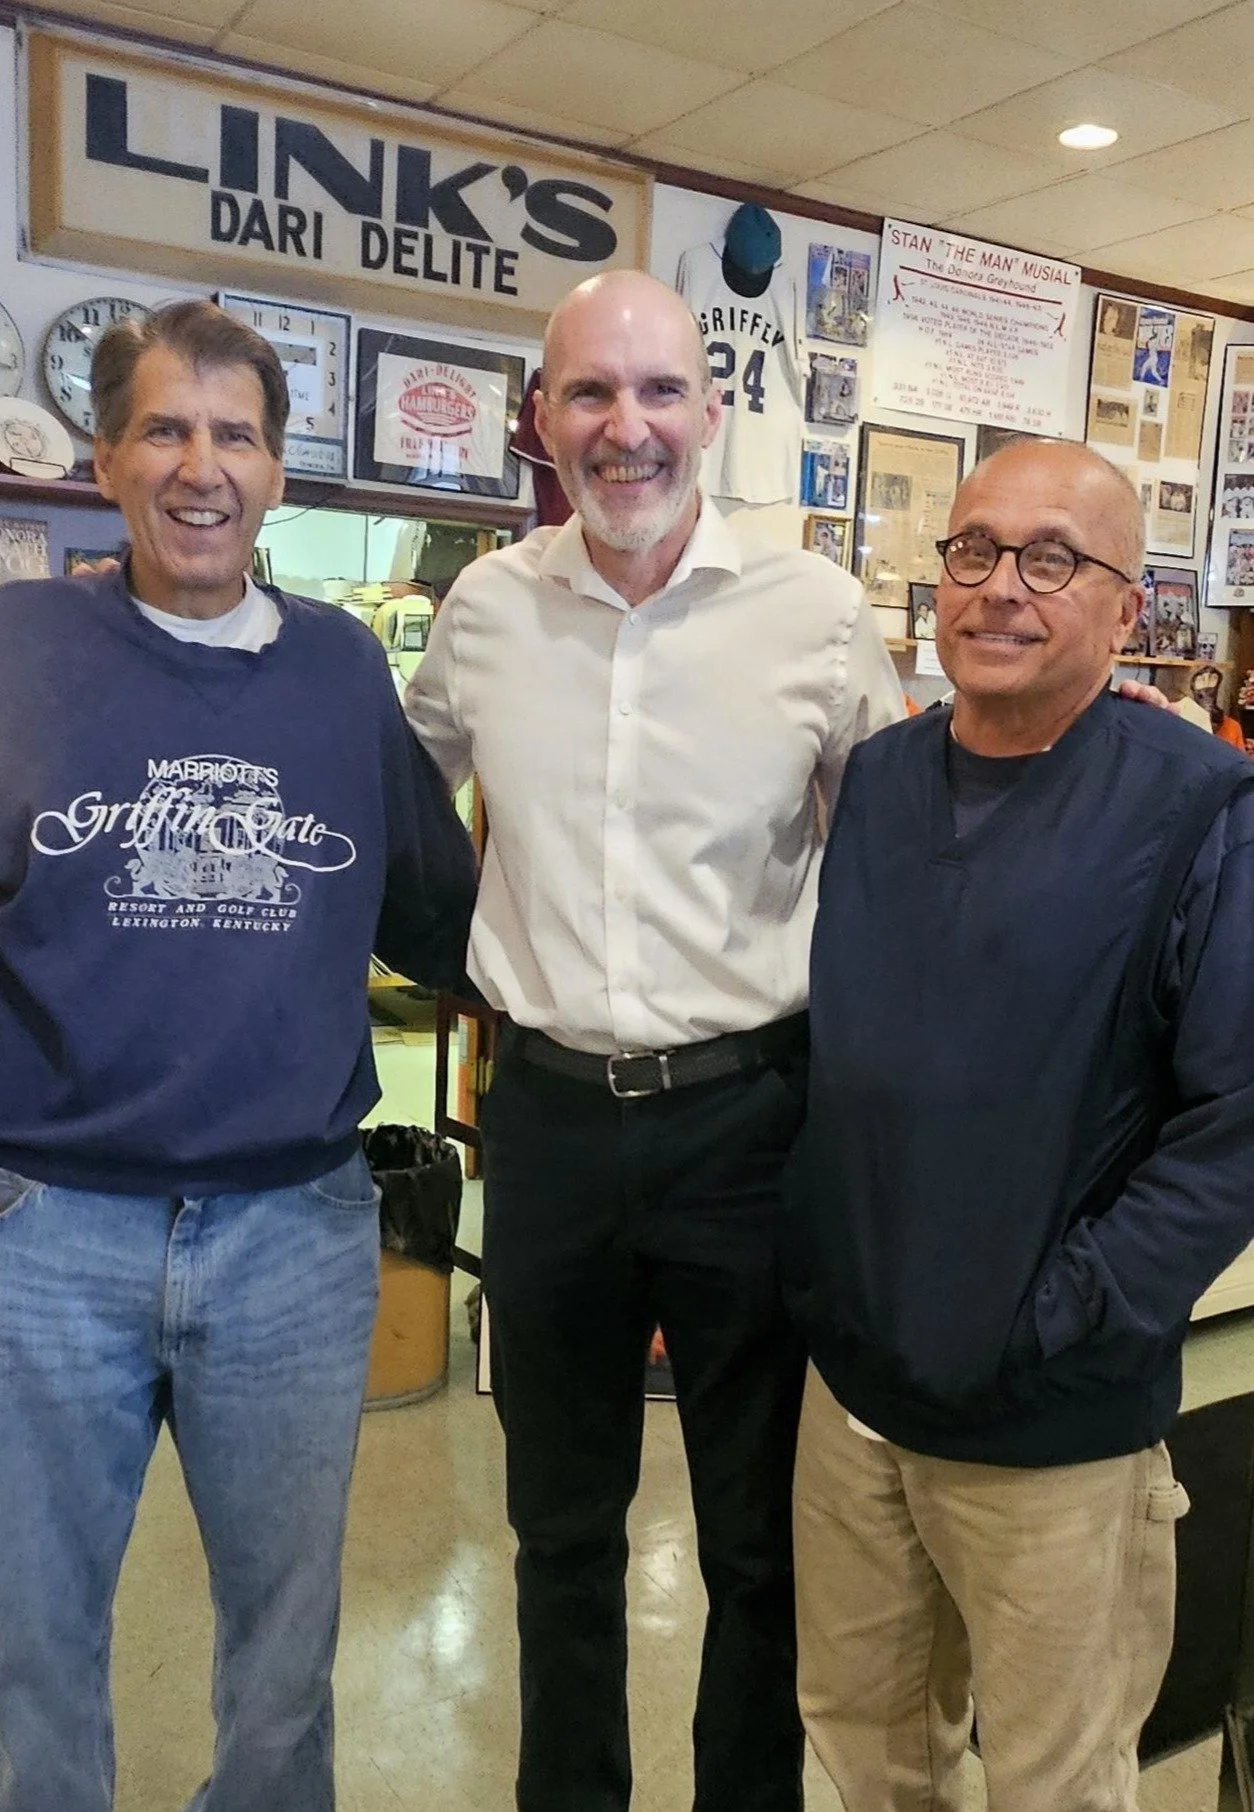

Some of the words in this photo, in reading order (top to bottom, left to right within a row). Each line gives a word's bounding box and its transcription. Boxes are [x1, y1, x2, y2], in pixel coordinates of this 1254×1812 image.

[85, 73, 617, 262] LINK'S
[211, 190, 323, 260] DARI
[361, 221, 519, 296] DELITE
[926, 259, 944, 273] The
[948, 264, 984, 283] Donora
[986, 273, 1037, 293] Greyhound
[980, 252, 1019, 272] MAN"
[1022, 261, 1071, 285] MUSIAL
[82, 307, 99, 326] 11
[253, 311, 262, 327] 11
[279, 315, 290, 331] 12
[329, 342, 336, 356] 2
[51, 355, 63, 371] 9
[328, 372, 336, 387] 3
[706, 341, 765, 414] 24
[60, 385, 72, 402] 8
[328, 402, 336, 417] 4
[400, 395, 476, 420] HAMBURGERS
[306, 416, 315, 431] 5
[31, 785, 217, 856] Griffin
[208, 797, 356, 872] Gate
[107, 902, 167, 914] RESORT
[175, 903, 206, 914] AND
[217, 904, 255, 916] GOLF
[261, 908, 297, 918] CLUB
[112, 917, 201, 929] LEXINGTON
[212, 919, 291, 932] KENTUCKY
